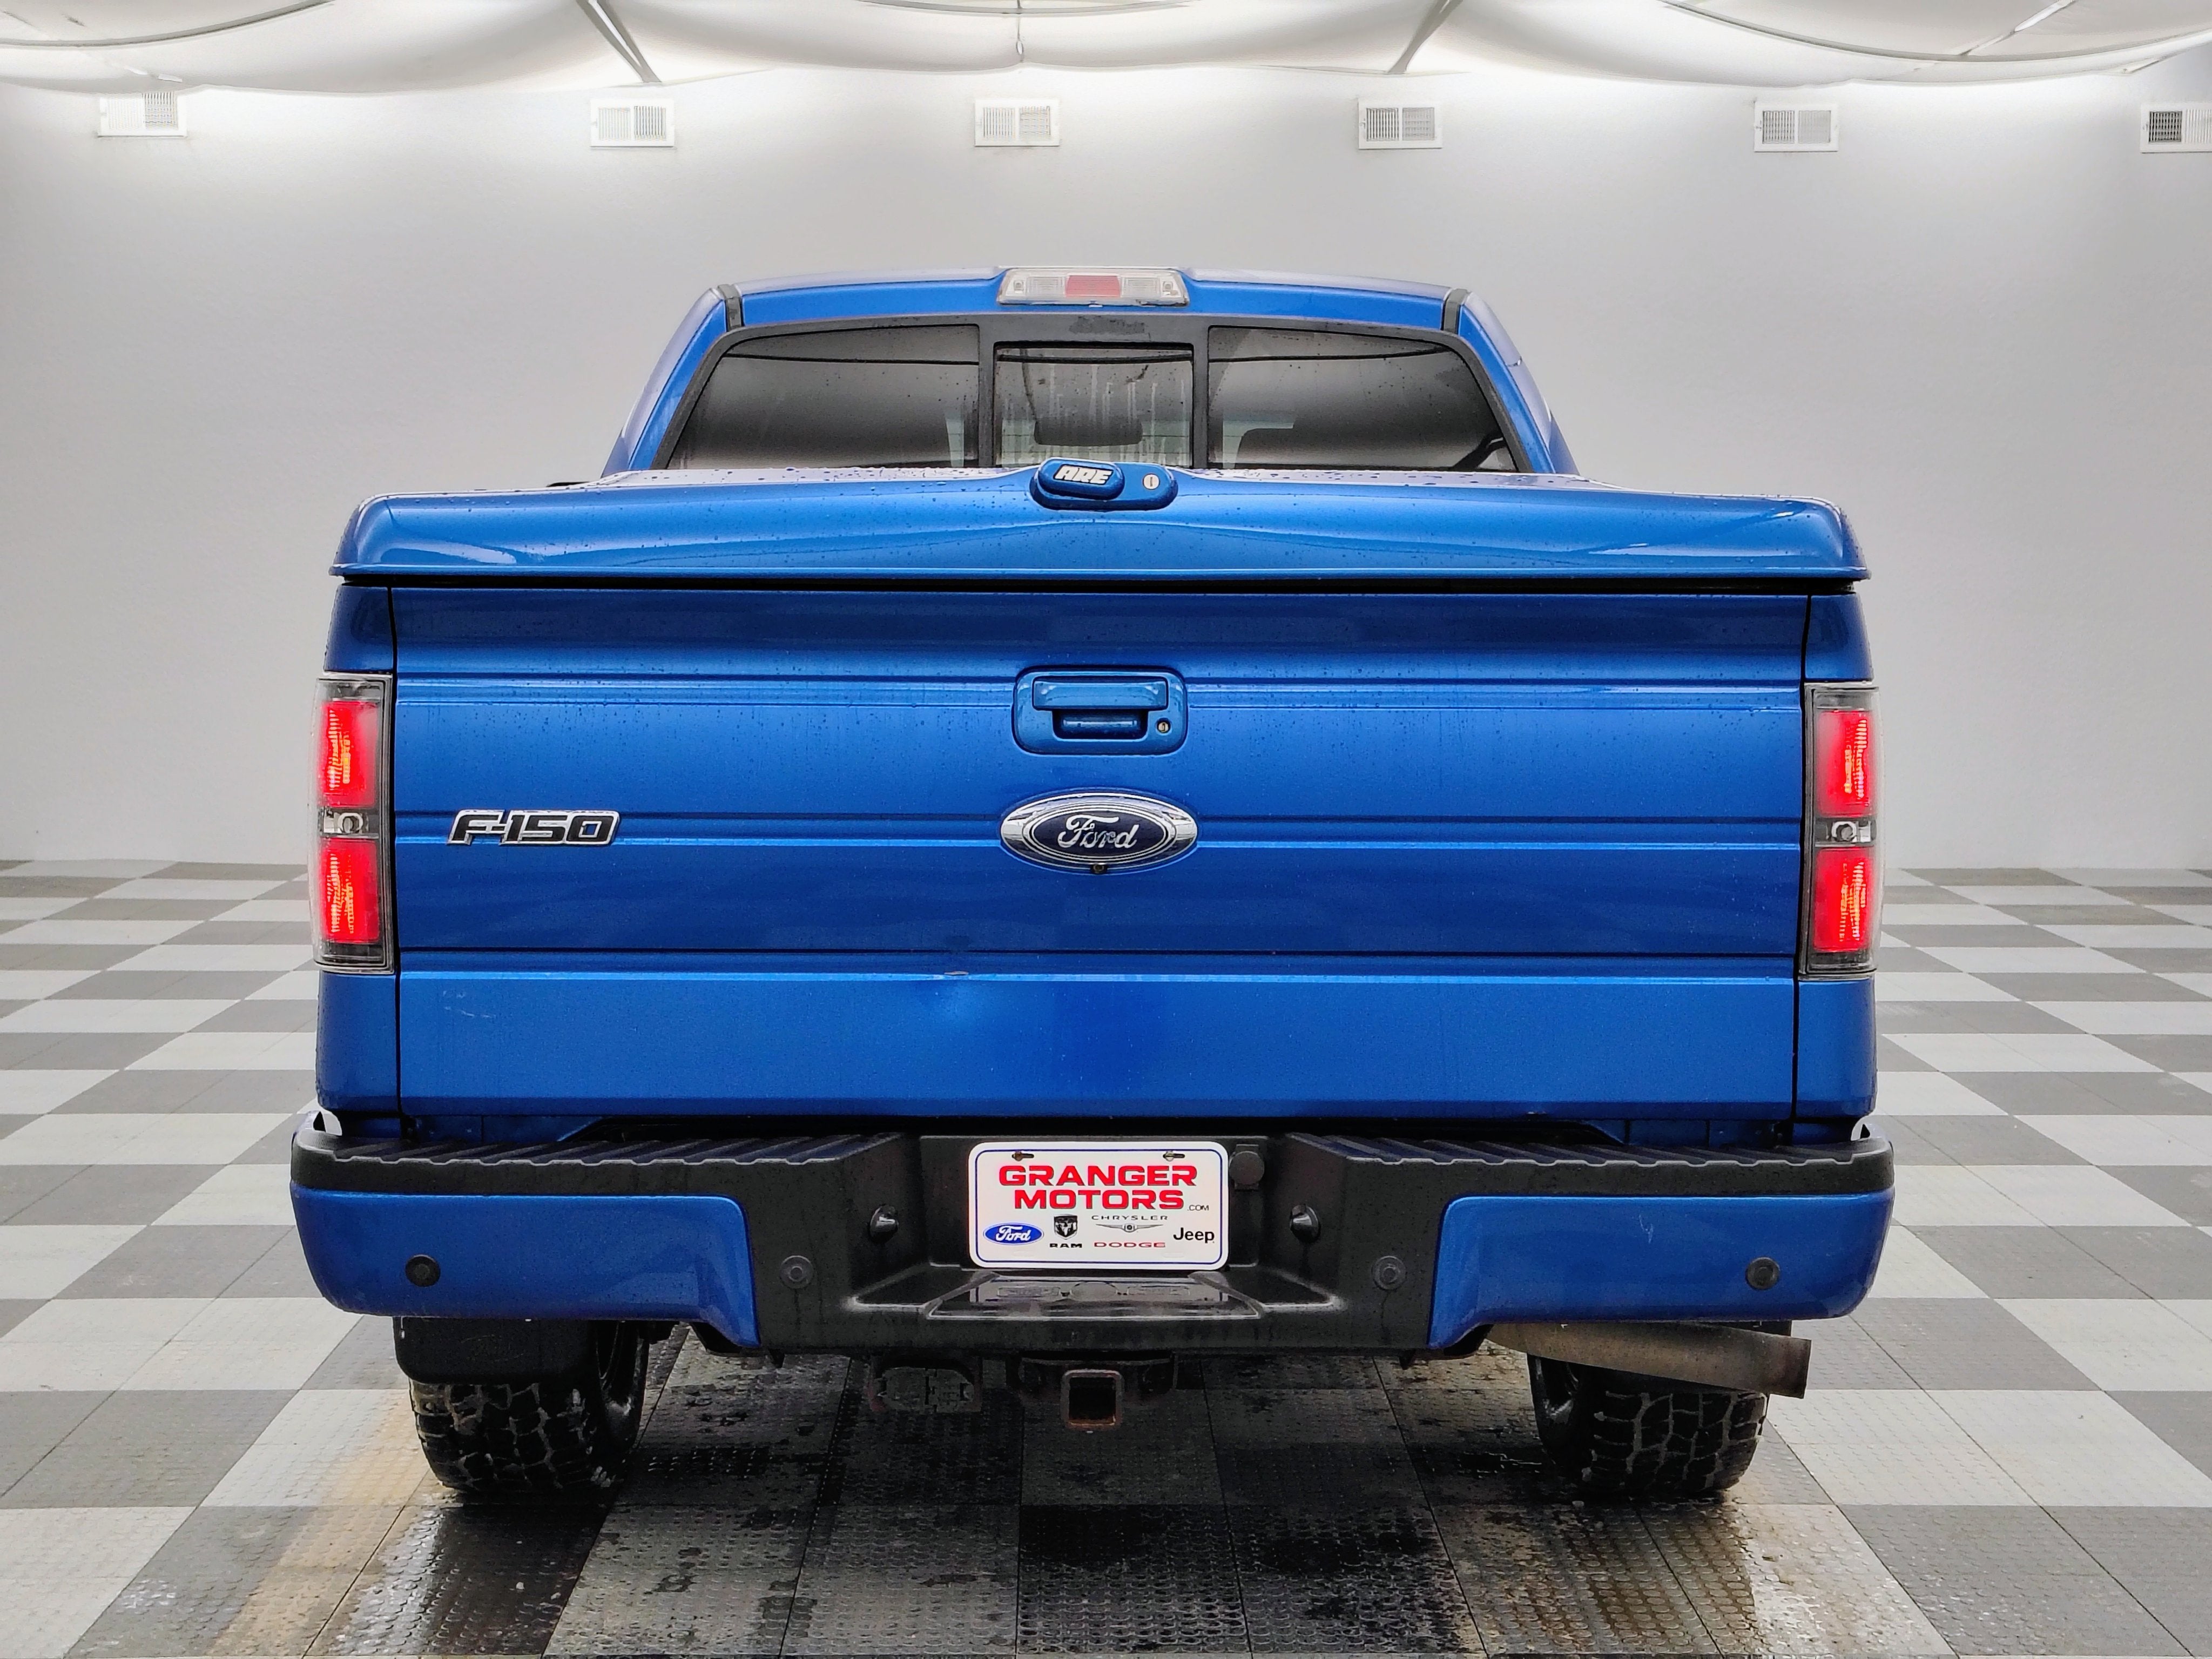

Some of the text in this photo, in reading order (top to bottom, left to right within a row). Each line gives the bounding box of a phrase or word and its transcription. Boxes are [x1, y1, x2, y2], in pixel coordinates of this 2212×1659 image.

[1055, 464, 1113, 484] ARE
[447, 809, 620, 846] F-150
[1057, 814, 1139, 848] Ford
[999, 1165, 1197, 1186] GRANGER
[1014, 1190, 1184, 1210] MOTORS
[995, 1226, 1031, 1242] Ford
[1173, 1228, 1215, 1243] Jeep
